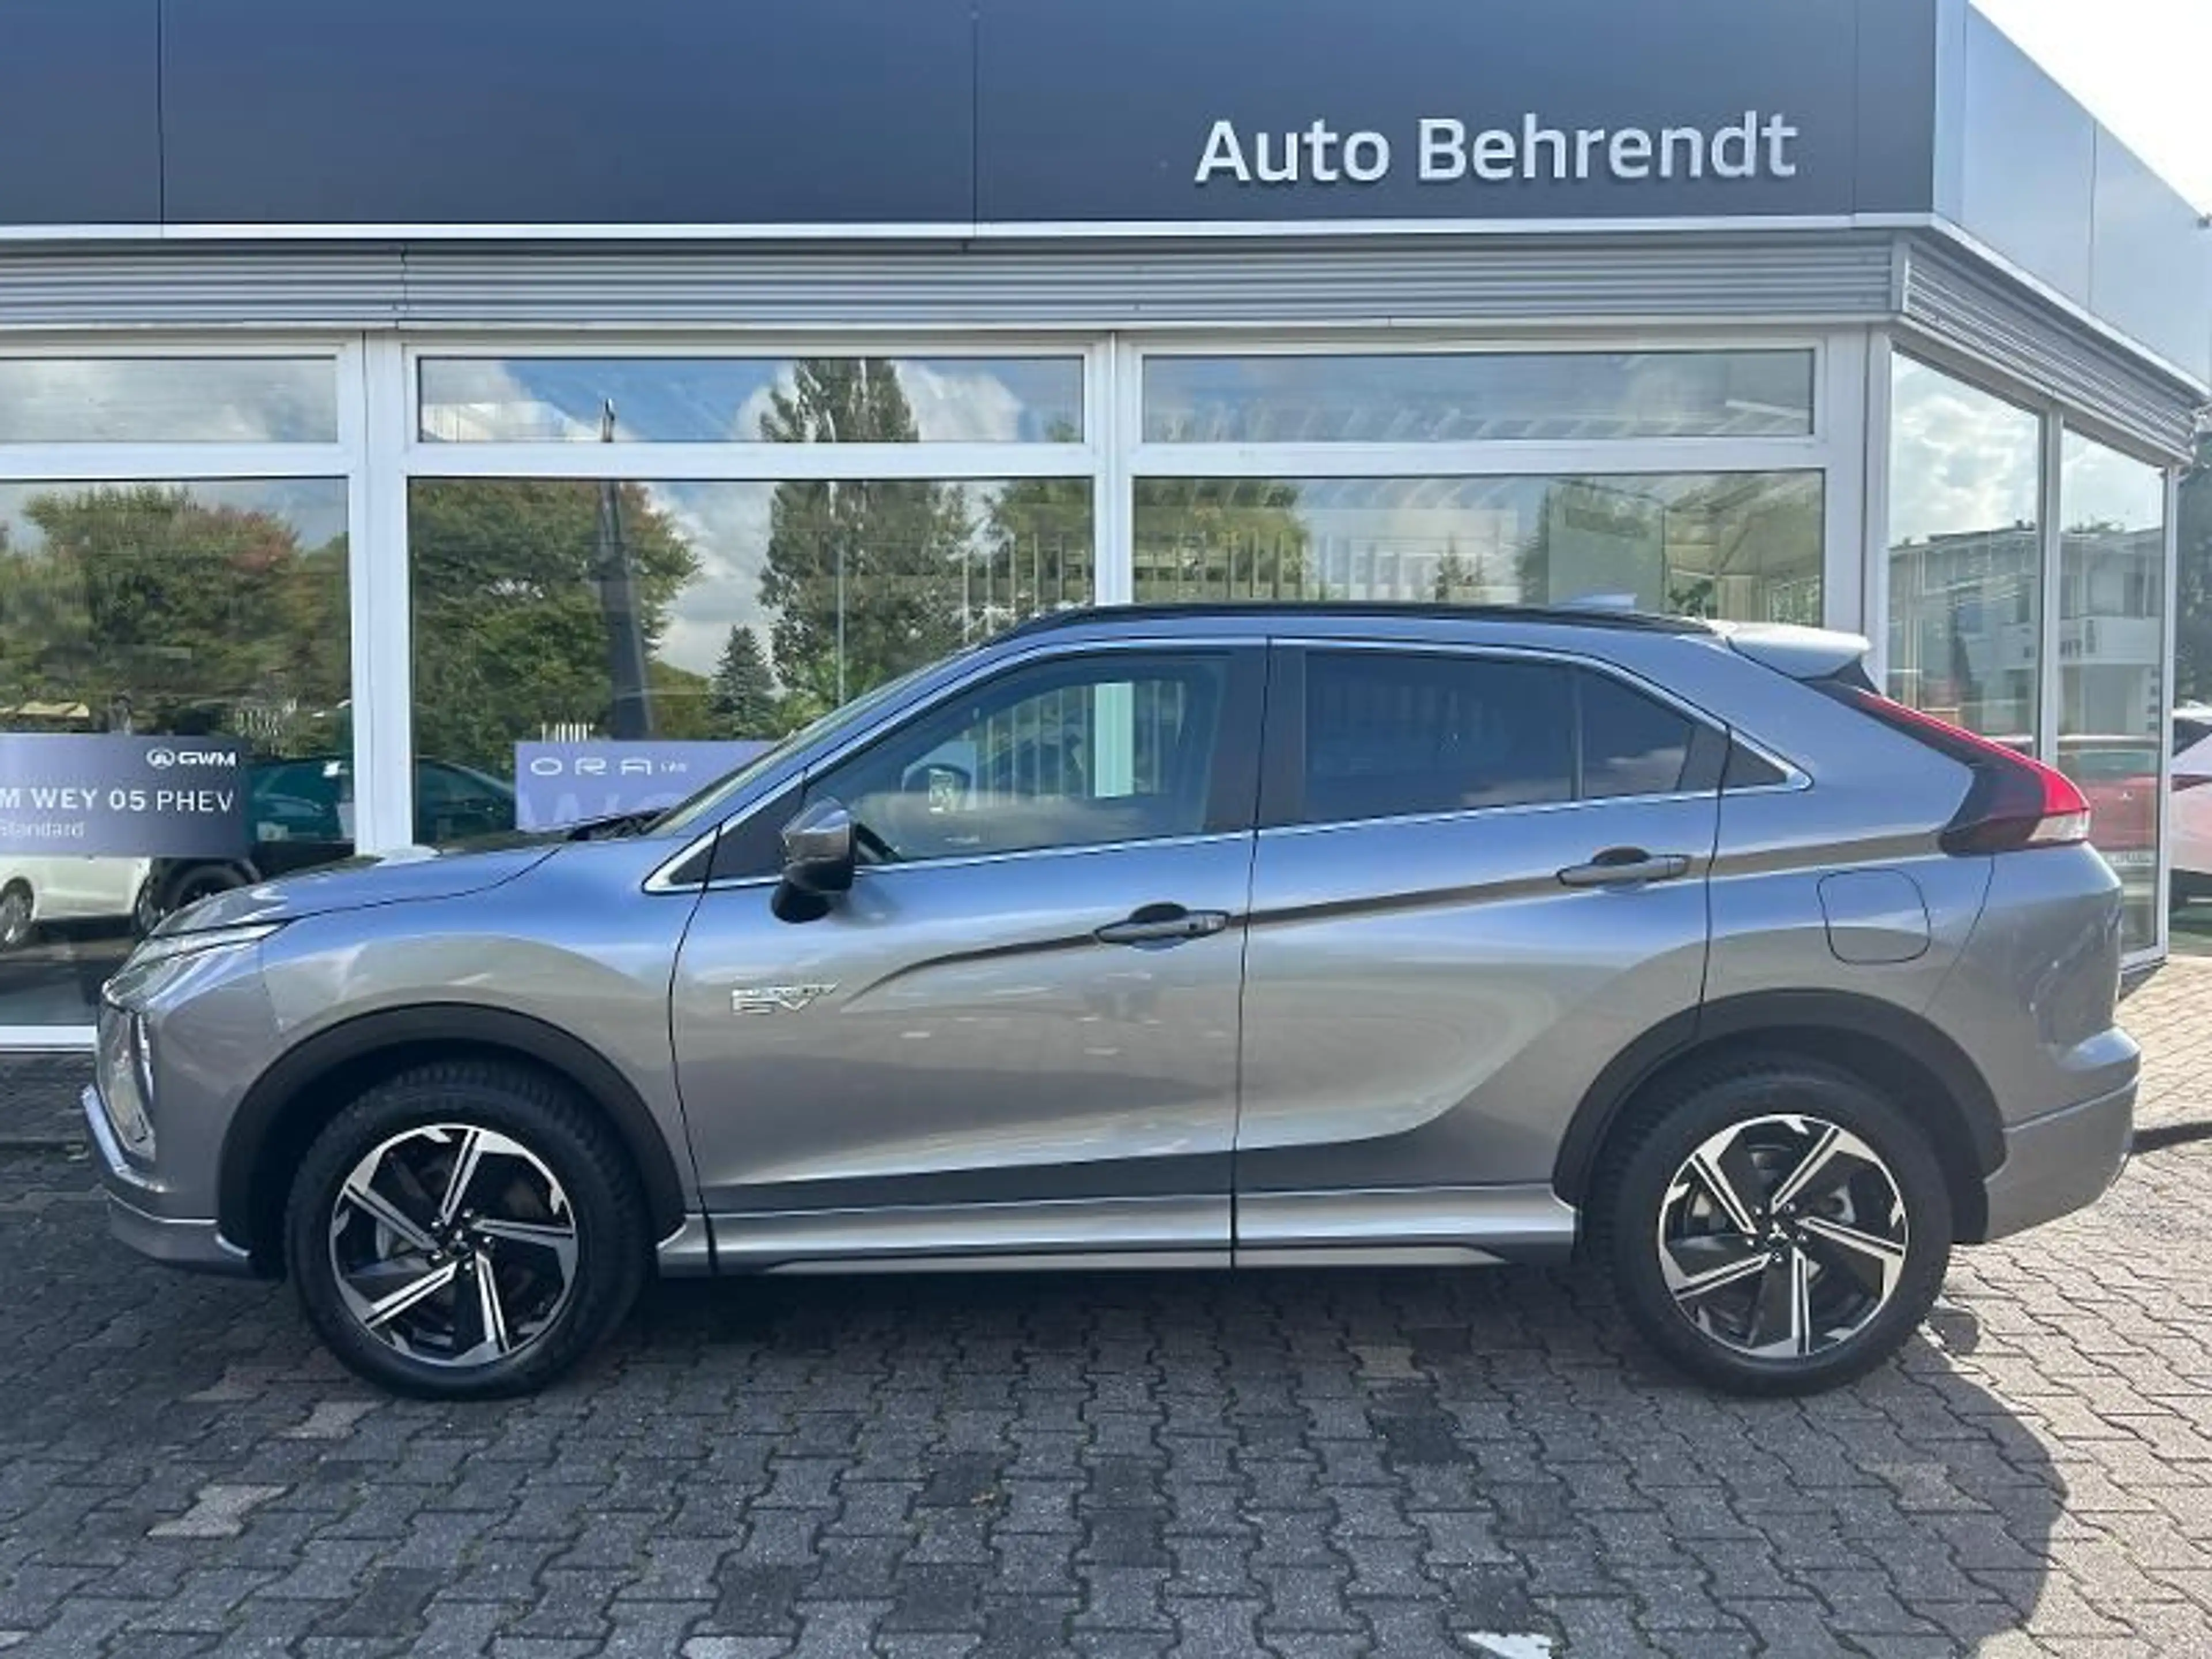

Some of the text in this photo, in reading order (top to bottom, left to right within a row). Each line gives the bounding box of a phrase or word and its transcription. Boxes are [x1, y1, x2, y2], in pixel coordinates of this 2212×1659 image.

[1195, 110, 1798, 182] Auto Behrendt
[178, 751, 236, 767] GWM
[530, 758, 652, 776] ORA
[30, 788, 98, 809] WEY
[109, 789, 146, 811] 05
[156, 790, 234, 812] PHEV
